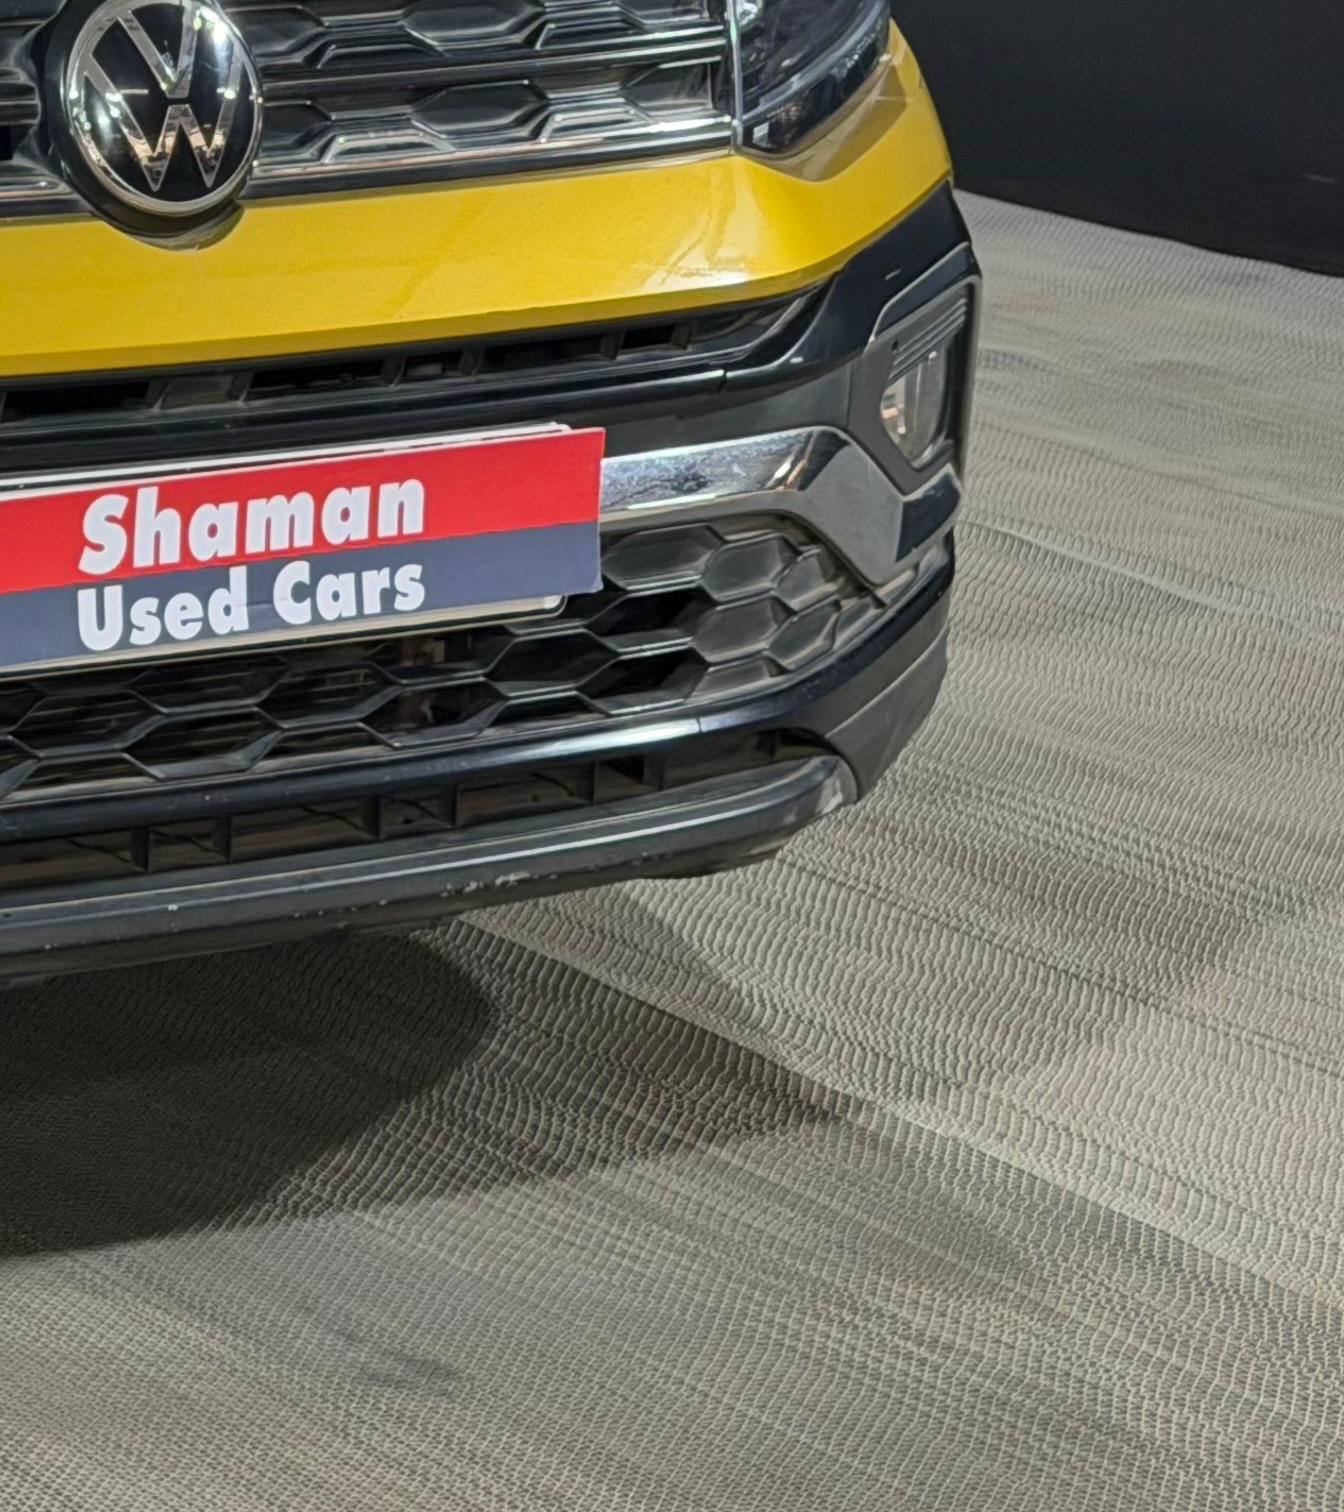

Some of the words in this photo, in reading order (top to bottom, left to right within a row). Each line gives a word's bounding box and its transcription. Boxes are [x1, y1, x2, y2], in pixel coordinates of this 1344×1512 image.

[78, 478, 425, 575] Shaman
[76, 565, 249, 652] Used
[272, 560, 426, 626] Cars
